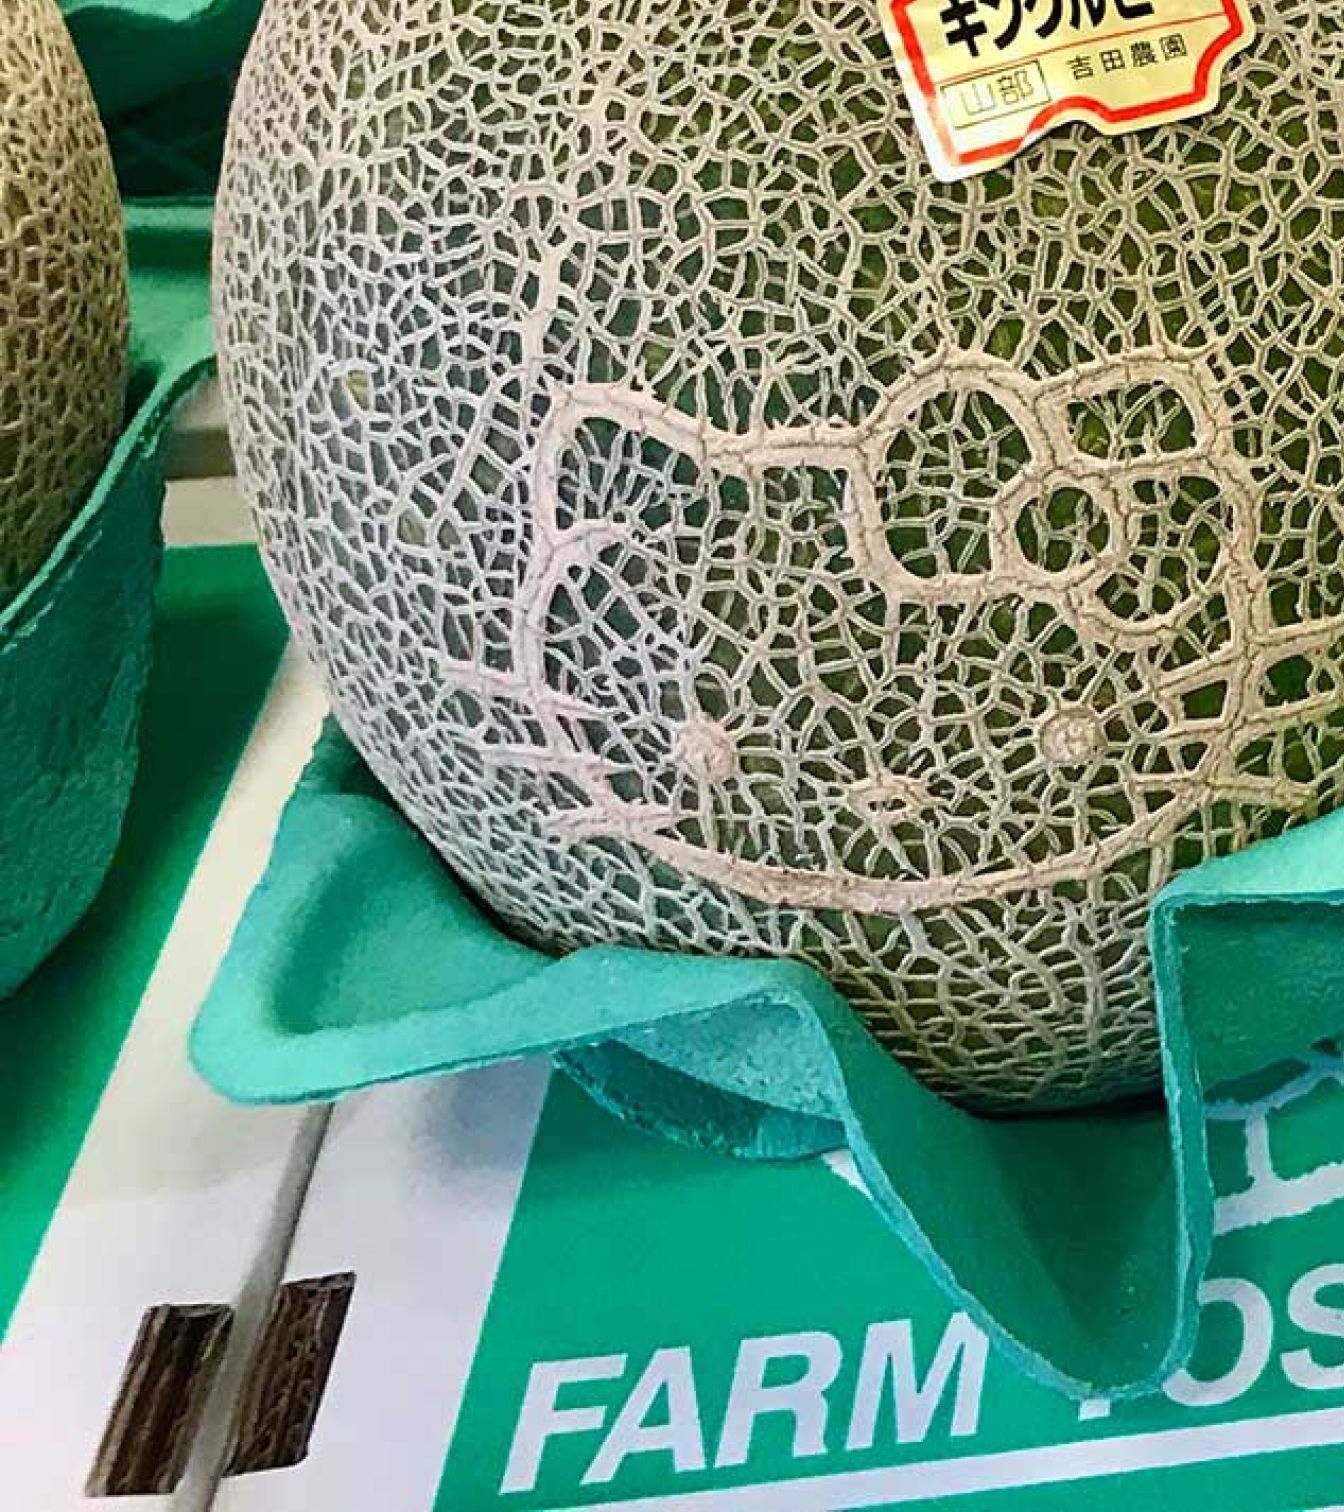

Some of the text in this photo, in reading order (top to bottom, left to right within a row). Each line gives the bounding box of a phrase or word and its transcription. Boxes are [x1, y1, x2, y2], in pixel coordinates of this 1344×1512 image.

[960, 32, 1189, 117] 山部 吉田農園
[498, 1309, 990, 1496] FARM
